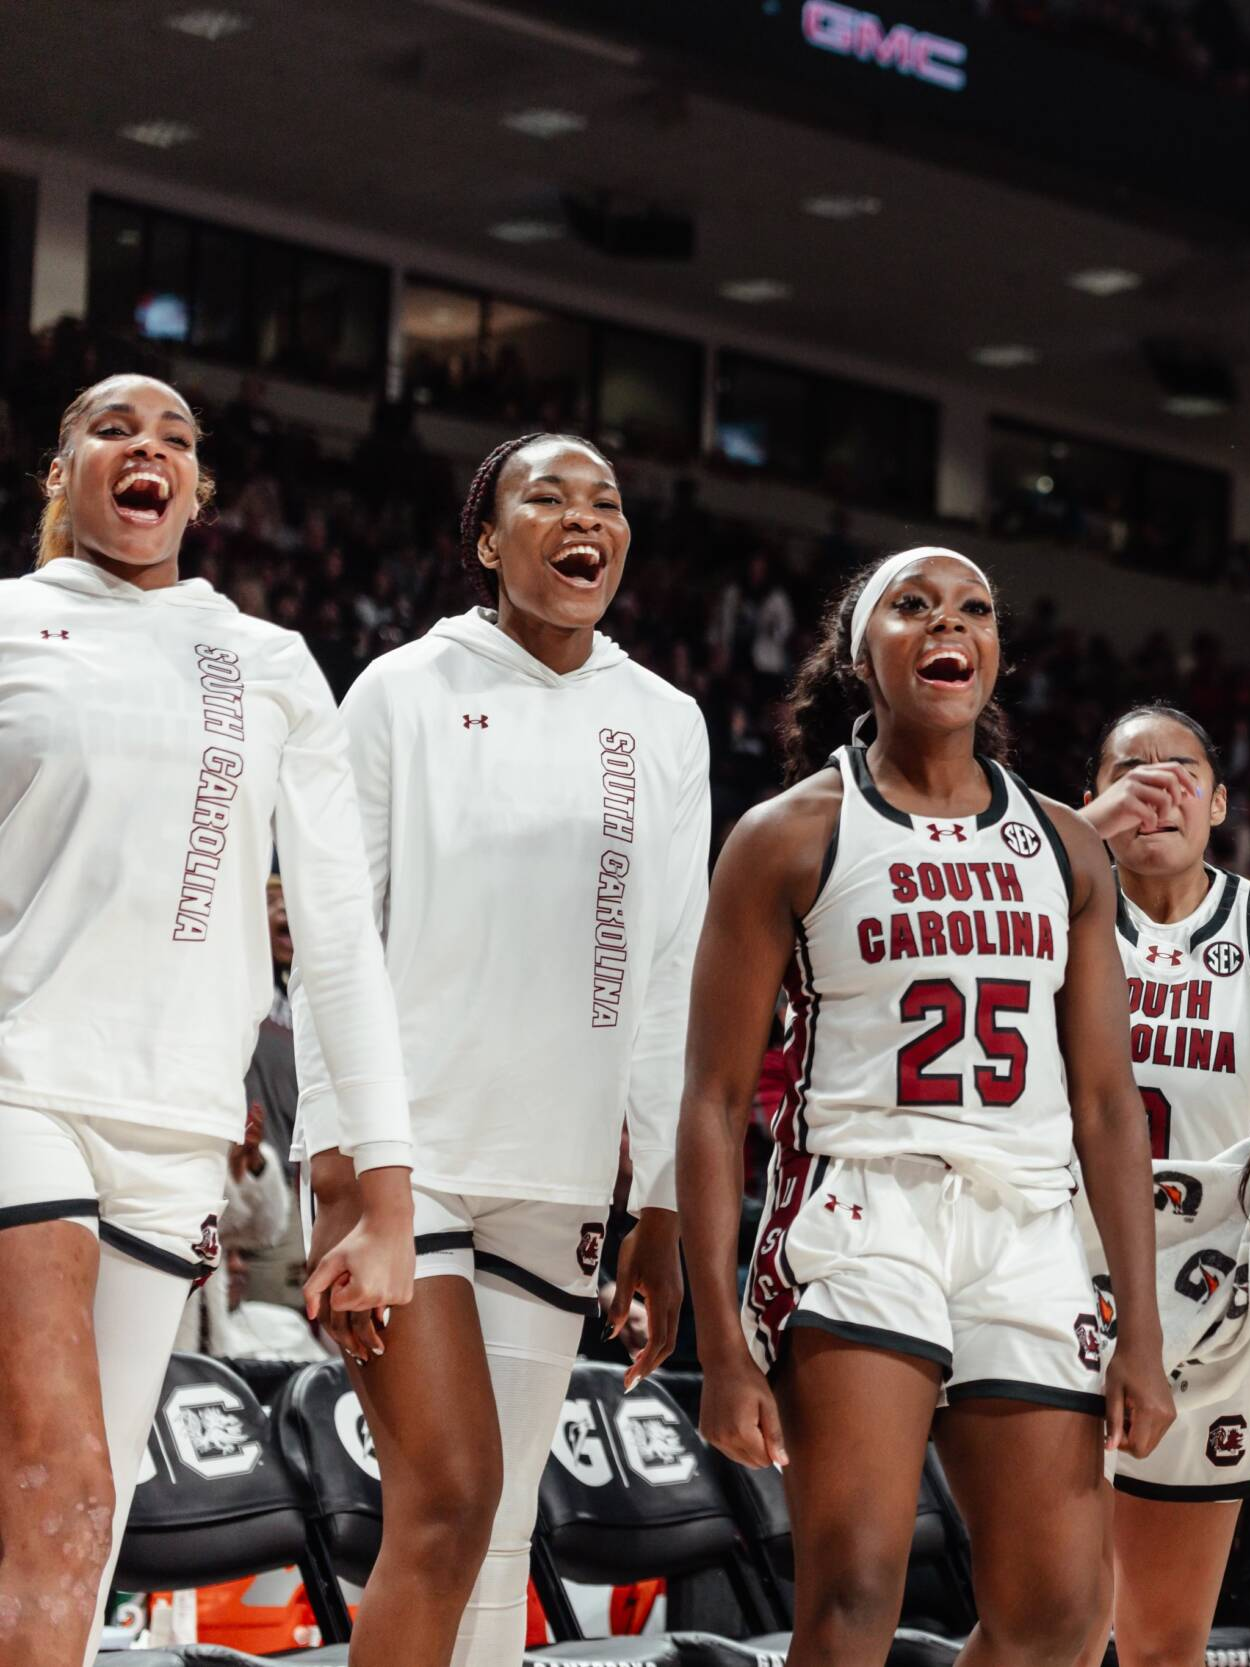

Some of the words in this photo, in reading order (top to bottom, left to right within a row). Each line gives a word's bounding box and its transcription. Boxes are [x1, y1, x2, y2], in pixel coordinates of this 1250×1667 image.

[801, 0, 967, 91] GMC
[194, 644, 245, 742] SOUTH
[599, 728, 636, 843] SOUTH
[172, 745, 245, 942] CAROLINA
[1003, 823, 1039, 856] SEC
[888, 862, 1024, 903] SOUTH
[591, 849, 630, 1028] CAROLINA
[857, 910, 1054, 964] CAROLINA
[1206, 942, 1242, 975] SEC
[1126, 977, 1212, 1020] OUTH
[896, 977, 1031, 1107] 25
[1131, 1023, 1236, 1074] OLINA
